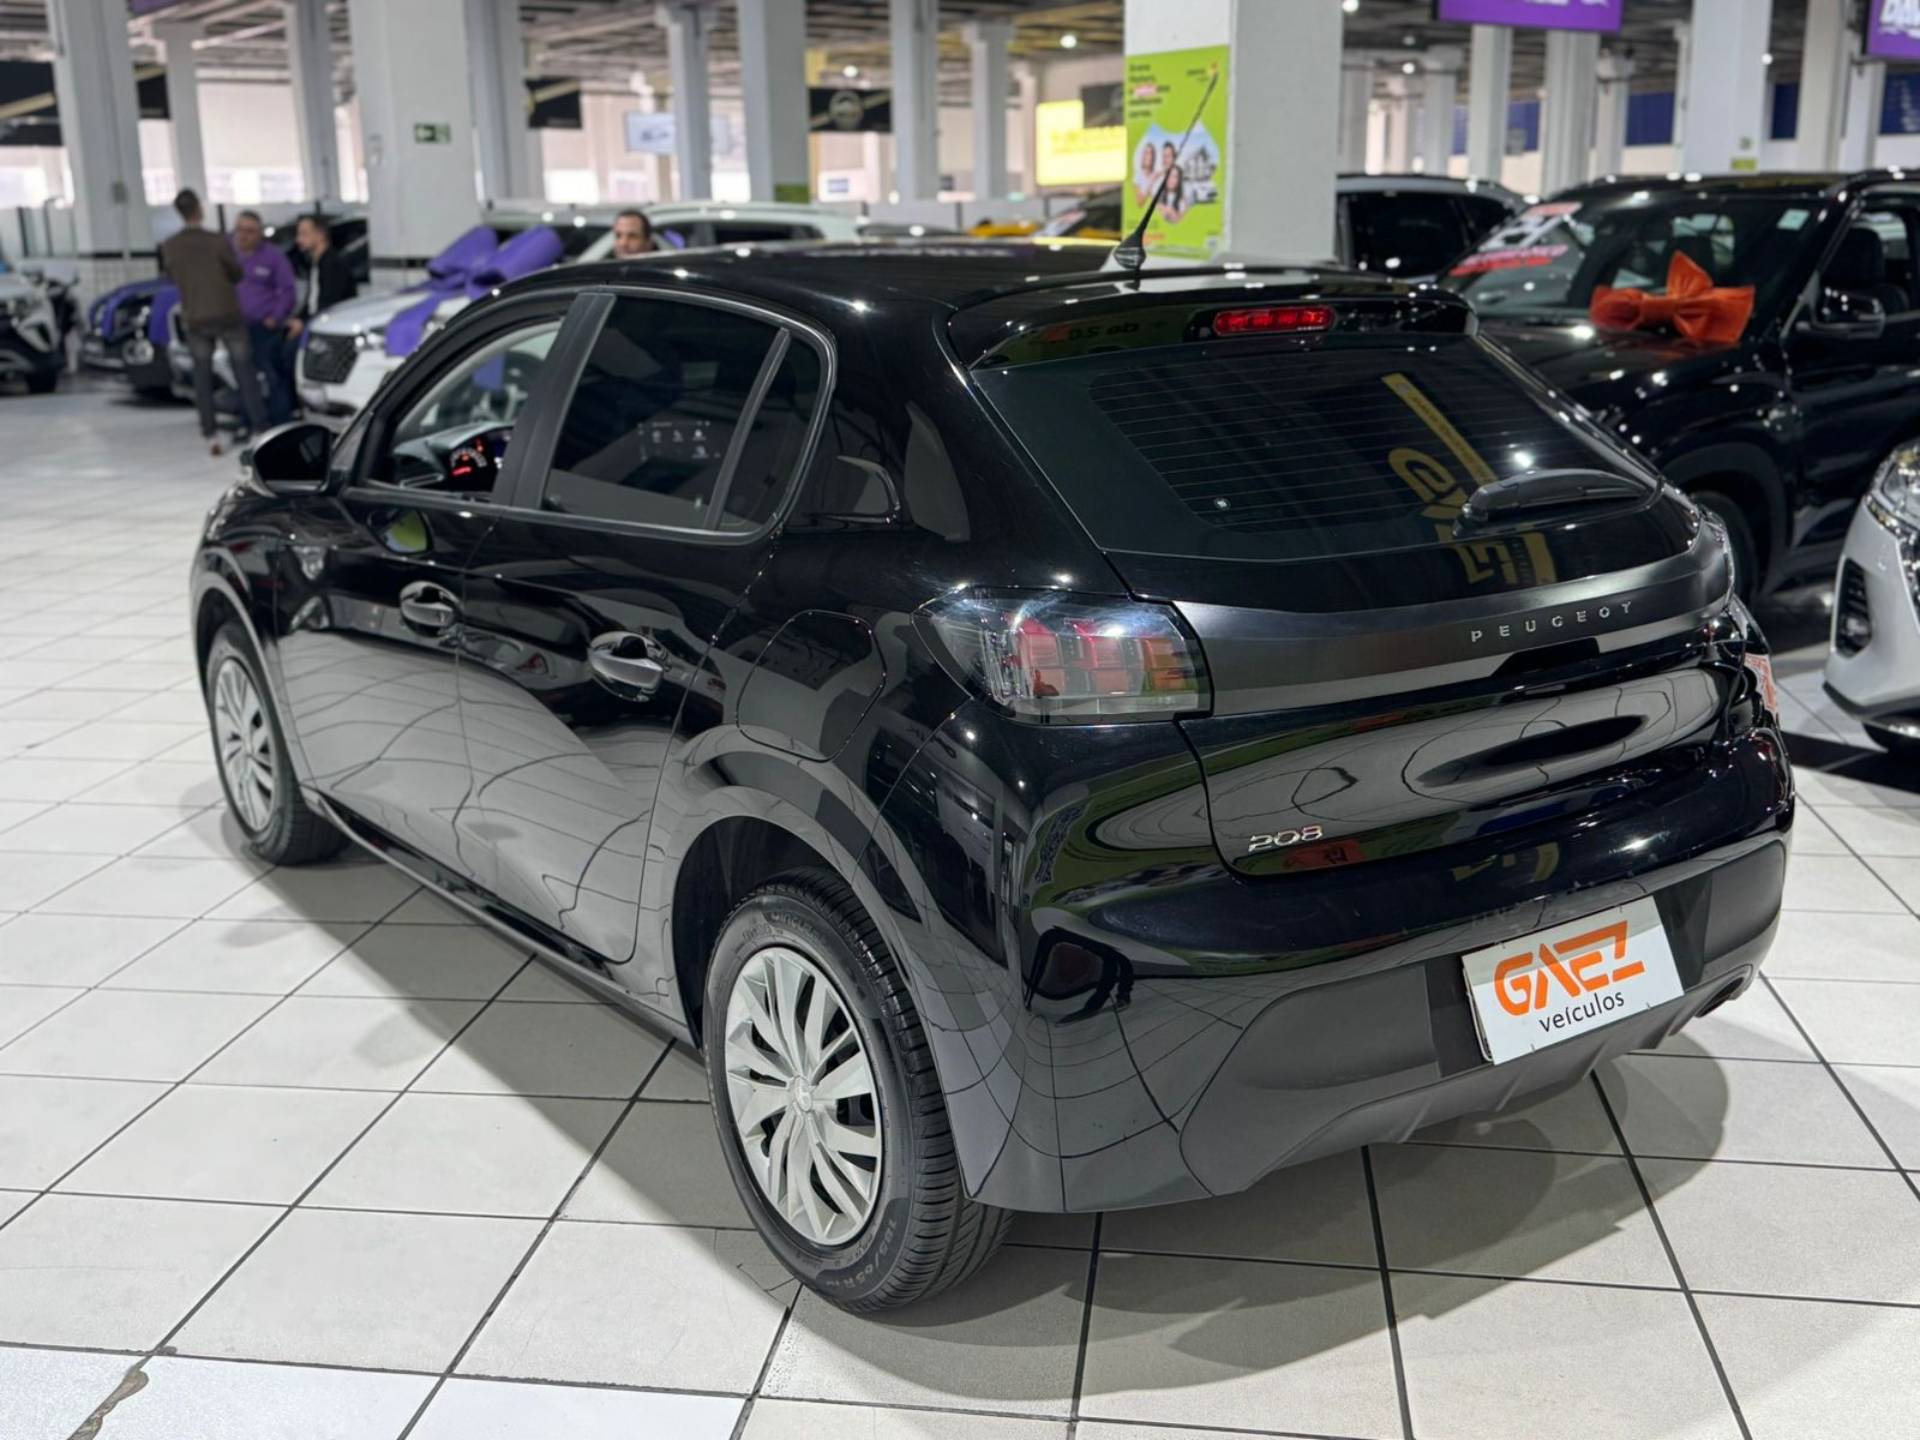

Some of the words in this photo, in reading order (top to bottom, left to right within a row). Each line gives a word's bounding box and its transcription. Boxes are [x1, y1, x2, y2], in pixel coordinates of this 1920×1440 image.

[1471, 601, 1632, 643] PEUGEOT
[1247, 824, 1324, 853] 208
[1494, 920, 1646, 1016] GAEZ
[1538, 991, 1625, 1033] veículos
